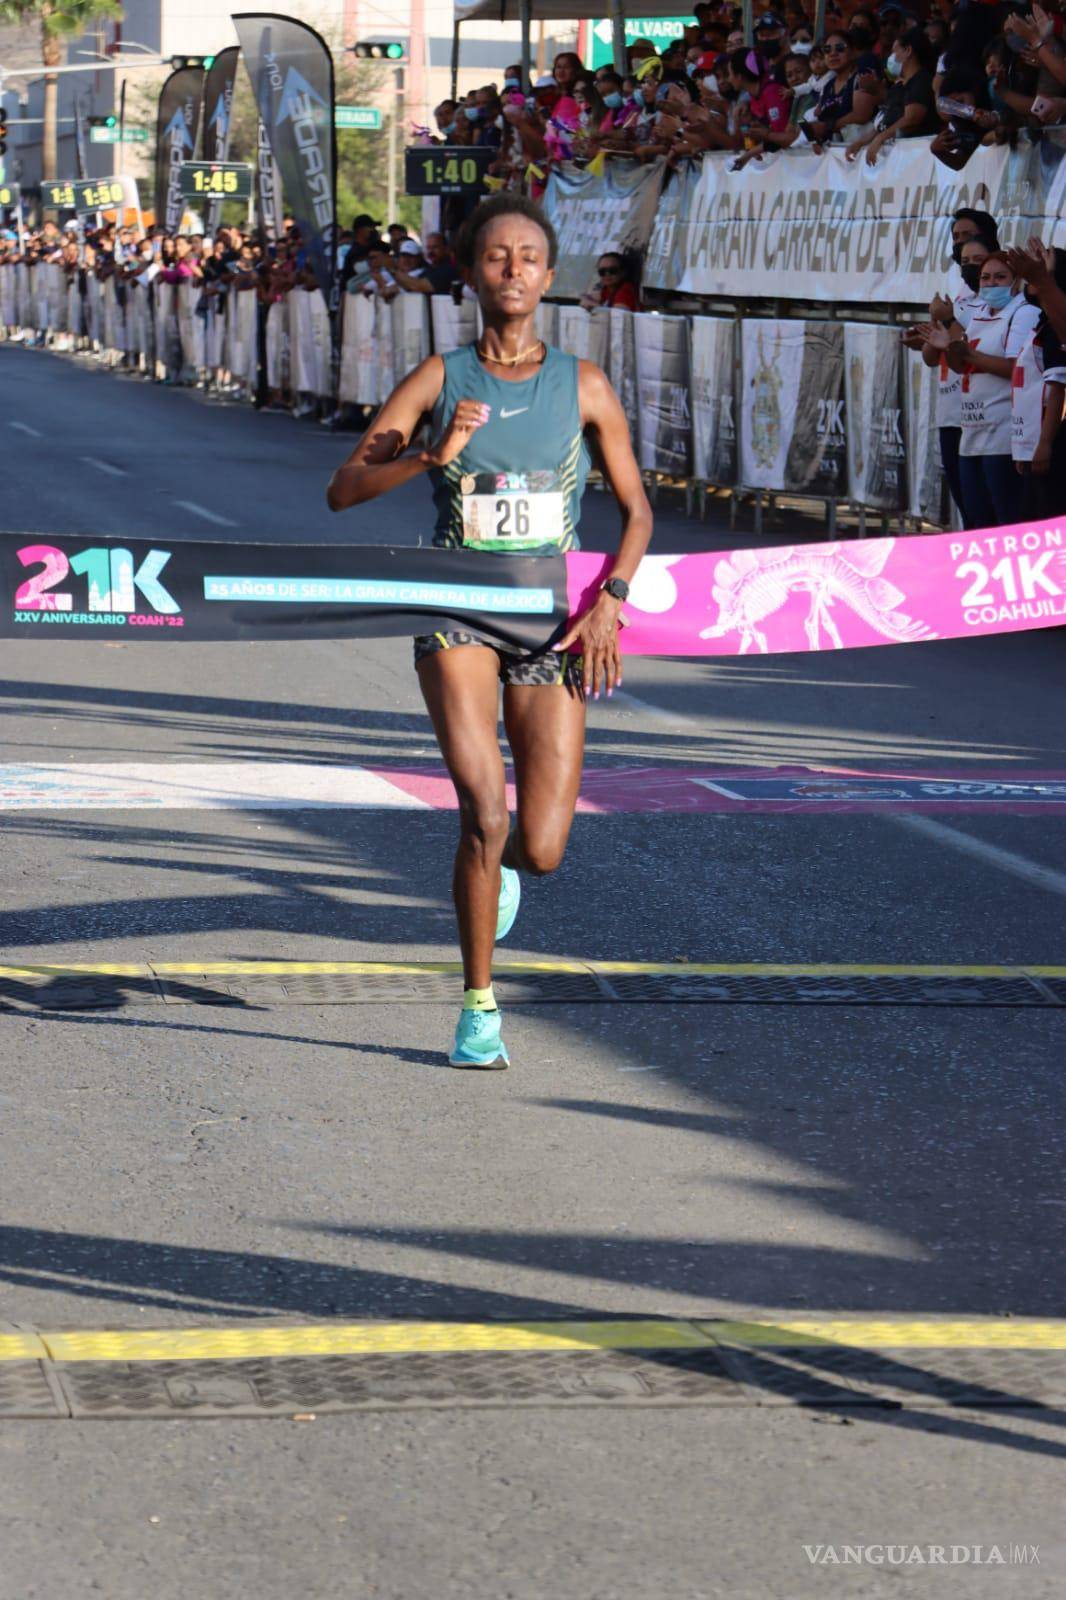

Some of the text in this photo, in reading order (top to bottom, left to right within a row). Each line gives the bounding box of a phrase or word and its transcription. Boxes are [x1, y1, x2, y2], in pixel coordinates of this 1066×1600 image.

[625, 22, 684, 37] ALVARO
[192, 169, 238, 193] 1:45
[421, 158, 478, 185] 1:40
[82, 183, 124, 207] 1:50
[855, 187, 895, 273] DE
[496, 499, 530, 537] 26
[15, 544, 182, 615] 21K
[231, 580, 276, 597] AÑOS
[278, 583, 298, 597] DE
[954, 550, 1064, 608] 21K
[14, 611, 40, 624] XXV
[42, 613, 126, 625] ANIVERSARIO
[128, 614, 164, 626] COAH
[963, 596, 1066, 626] COAHUIL
